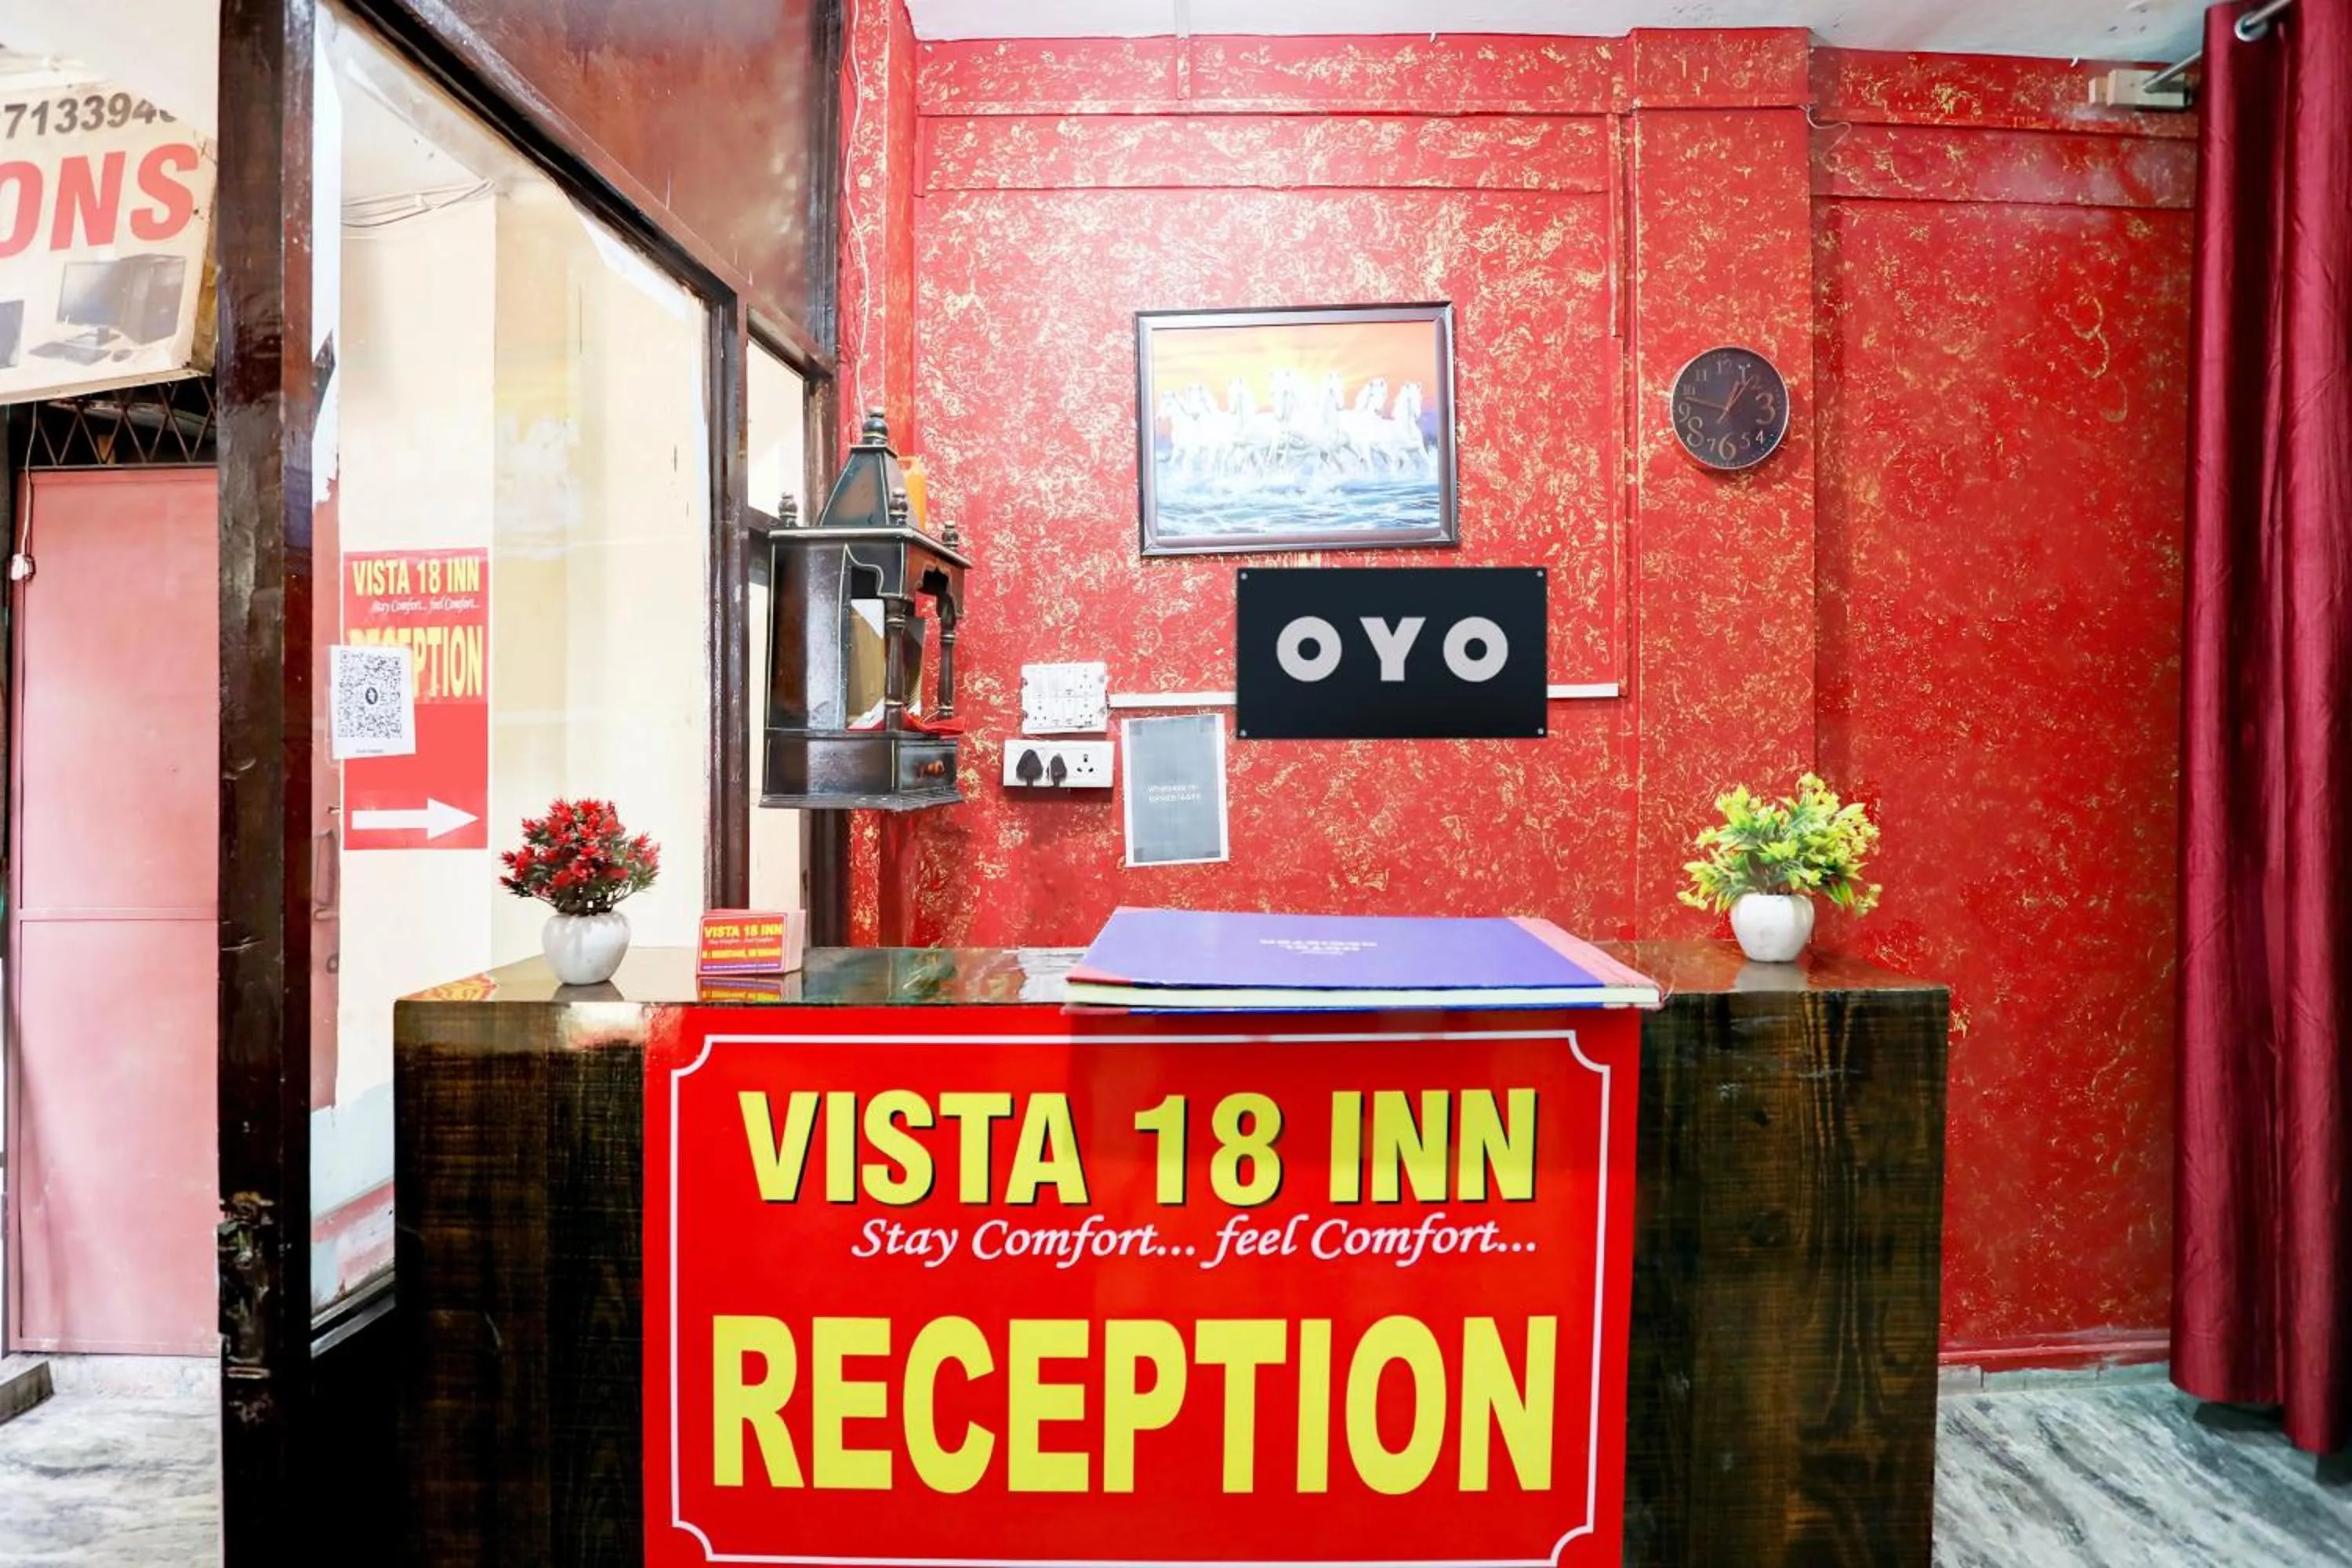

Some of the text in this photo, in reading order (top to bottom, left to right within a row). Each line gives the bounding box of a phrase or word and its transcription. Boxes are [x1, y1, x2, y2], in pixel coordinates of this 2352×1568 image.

[4, 93, 177, 139] 713394
[1716, 358, 1732, 375] 12
[1679, 401, 1691, 423] 9
[1755, 392, 1776, 425] 3
[1686, 416, 1704, 448] 8
[1708, 437, 1715, 452] 7
[1719, 432, 1737, 461] 6
[1740, 432, 1751, 448] 5
[1755, 430, 1763, 445] 4
[353, 556, 480, 597] VISTA 18 INN
[350, 625, 483, 699] PTION
[1276, 615, 1509, 683] OYO
[704, 925, 740, 938] VISTA
[739, 1088, 1537, 1206] VISTA 18 INN
[851, 1212, 1537, 1269] Stay Comfort... feel Comfort...
[713, 1314, 1558, 1495] RECEPTION
